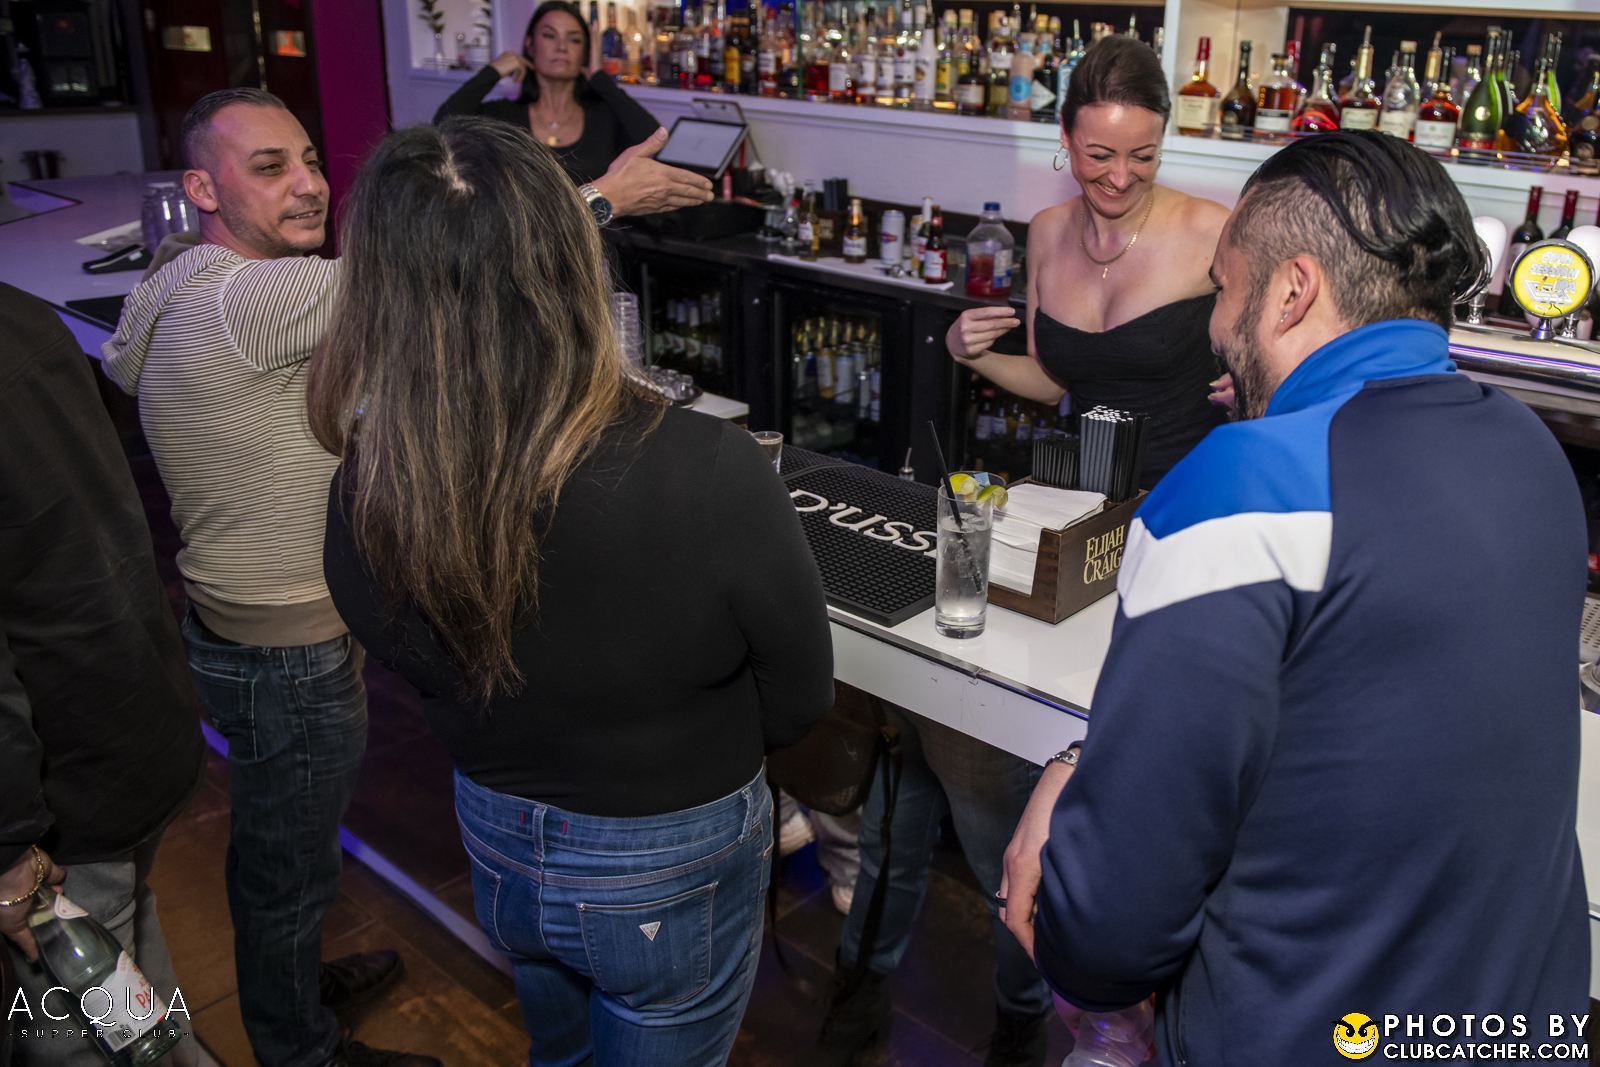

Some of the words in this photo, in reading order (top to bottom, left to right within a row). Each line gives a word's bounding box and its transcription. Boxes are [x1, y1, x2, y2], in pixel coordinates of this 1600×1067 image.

[790, 488, 937, 558] D'USS
[1084, 524, 1125, 563] ELIJAH
[1083, 546, 1124, 585] CRAIG
